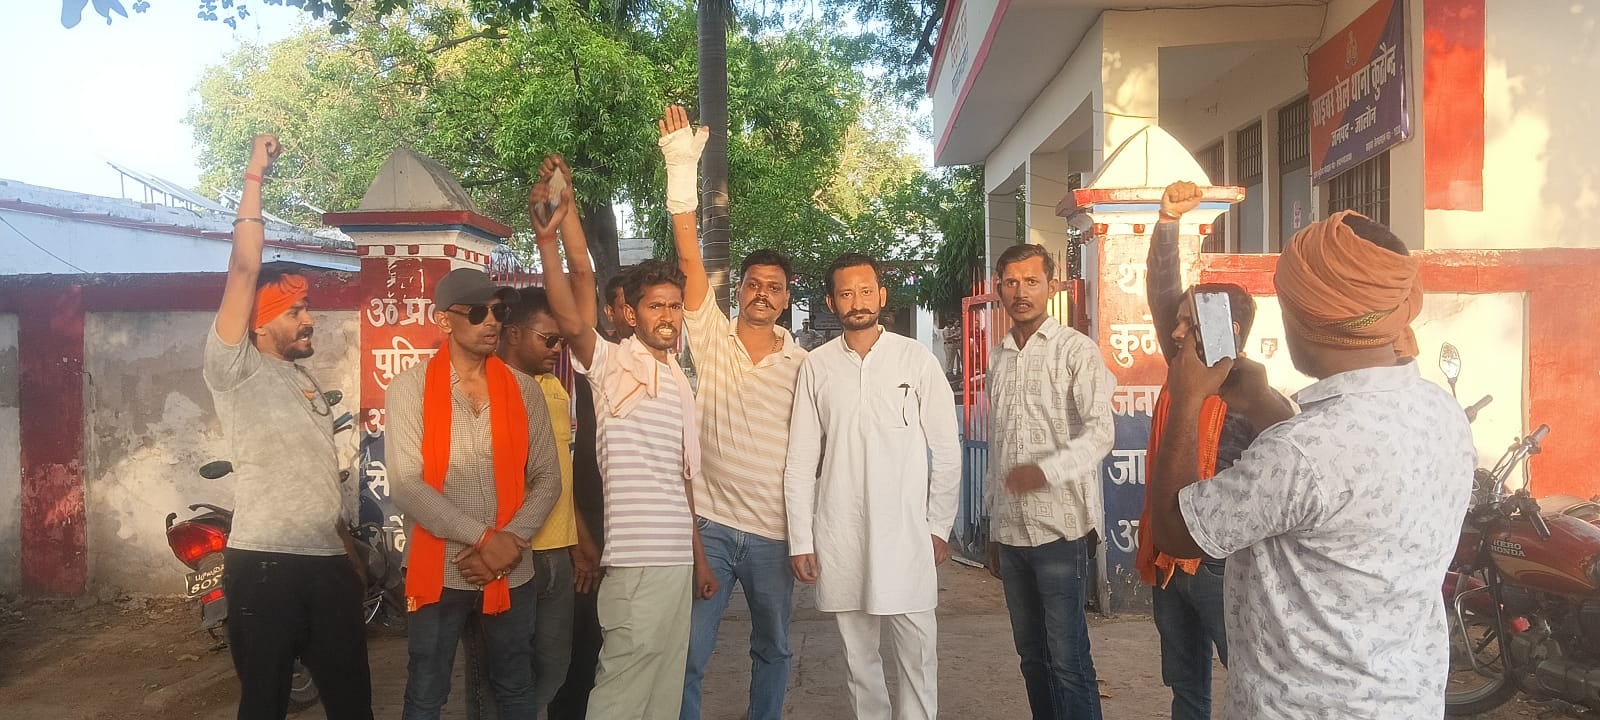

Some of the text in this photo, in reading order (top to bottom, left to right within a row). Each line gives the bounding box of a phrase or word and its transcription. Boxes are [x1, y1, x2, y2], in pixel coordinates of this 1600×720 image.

[1312, 88, 1334, 127] साइबर
[1335, 75, 1350, 113] सेल
[1351, 63, 1371, 102] थाना
[1331, 122, 1350, 147] जनपद
[1354, 104, 1377, 134] जालौन
[1490, 545, 1526, 557] HONDA
[1493, 539, 1522, 550] HERO
[191, 574, 222, 594] 805
